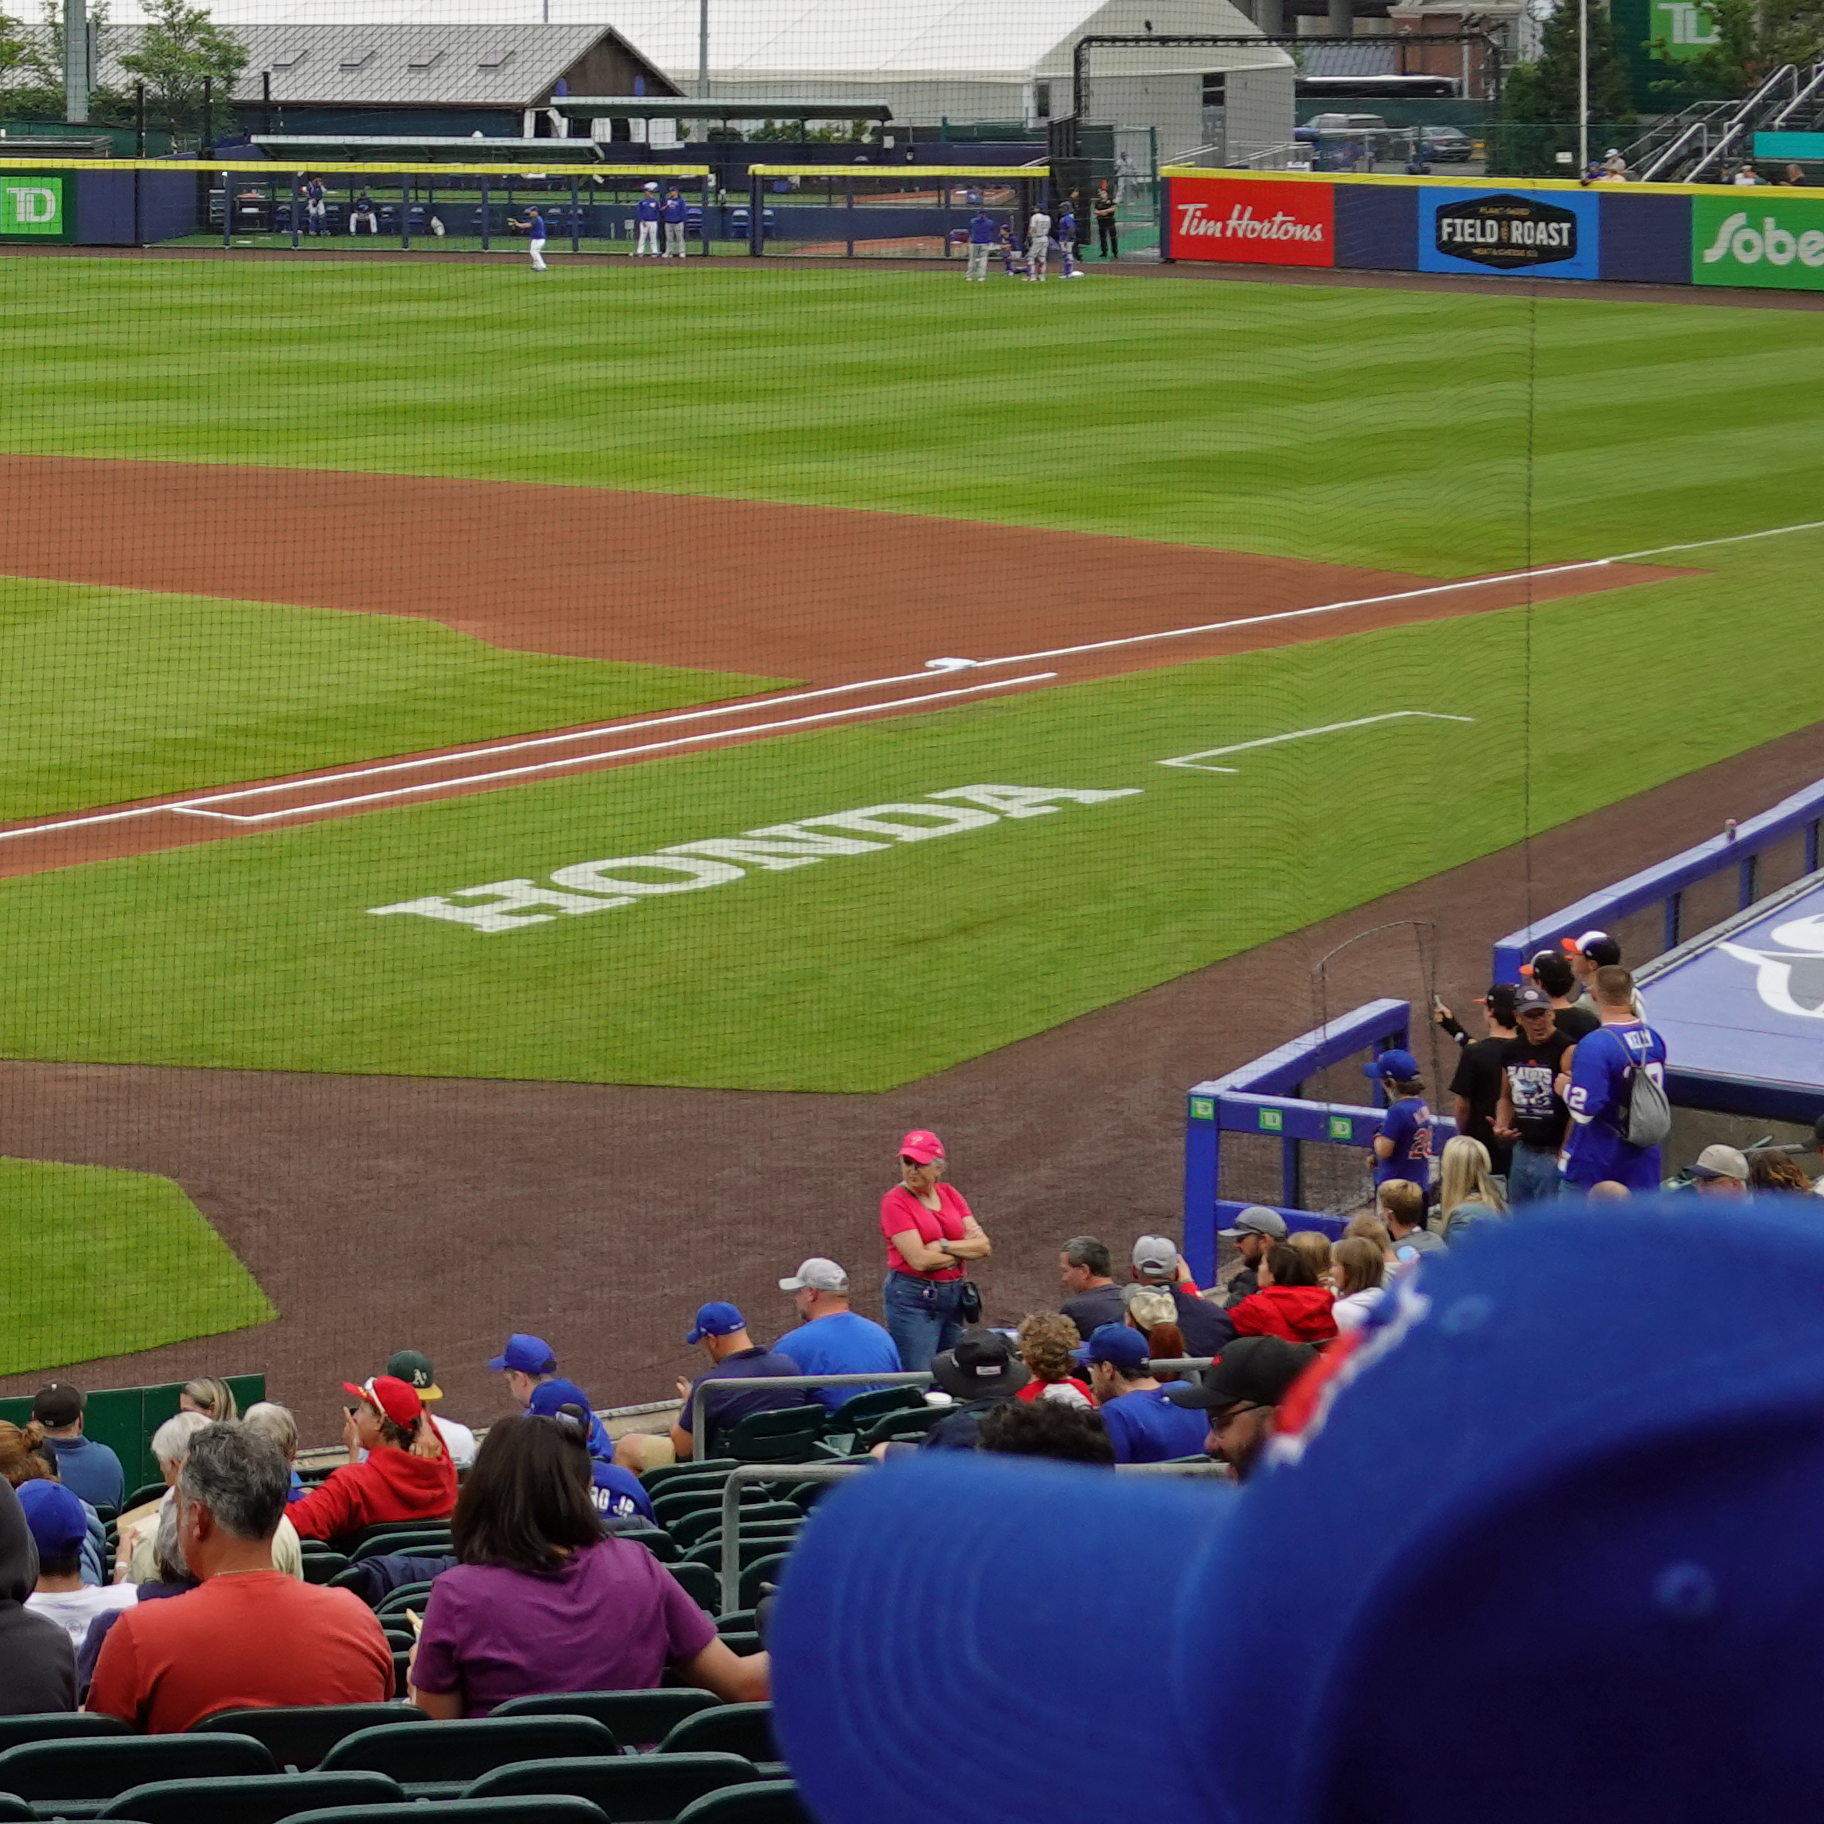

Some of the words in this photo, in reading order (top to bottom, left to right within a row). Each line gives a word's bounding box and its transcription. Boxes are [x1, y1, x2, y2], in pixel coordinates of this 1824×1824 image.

[6, 187, 56, 223] TD
[1177, 203, 1222, 238] Tim
[1226, 203, 1324, 242] Hortons
[1441, 218, 1499, 243] FIELD
[1510, 220, 1572, 247] ROAST
[365, 783, 1145, 932] HONDA
